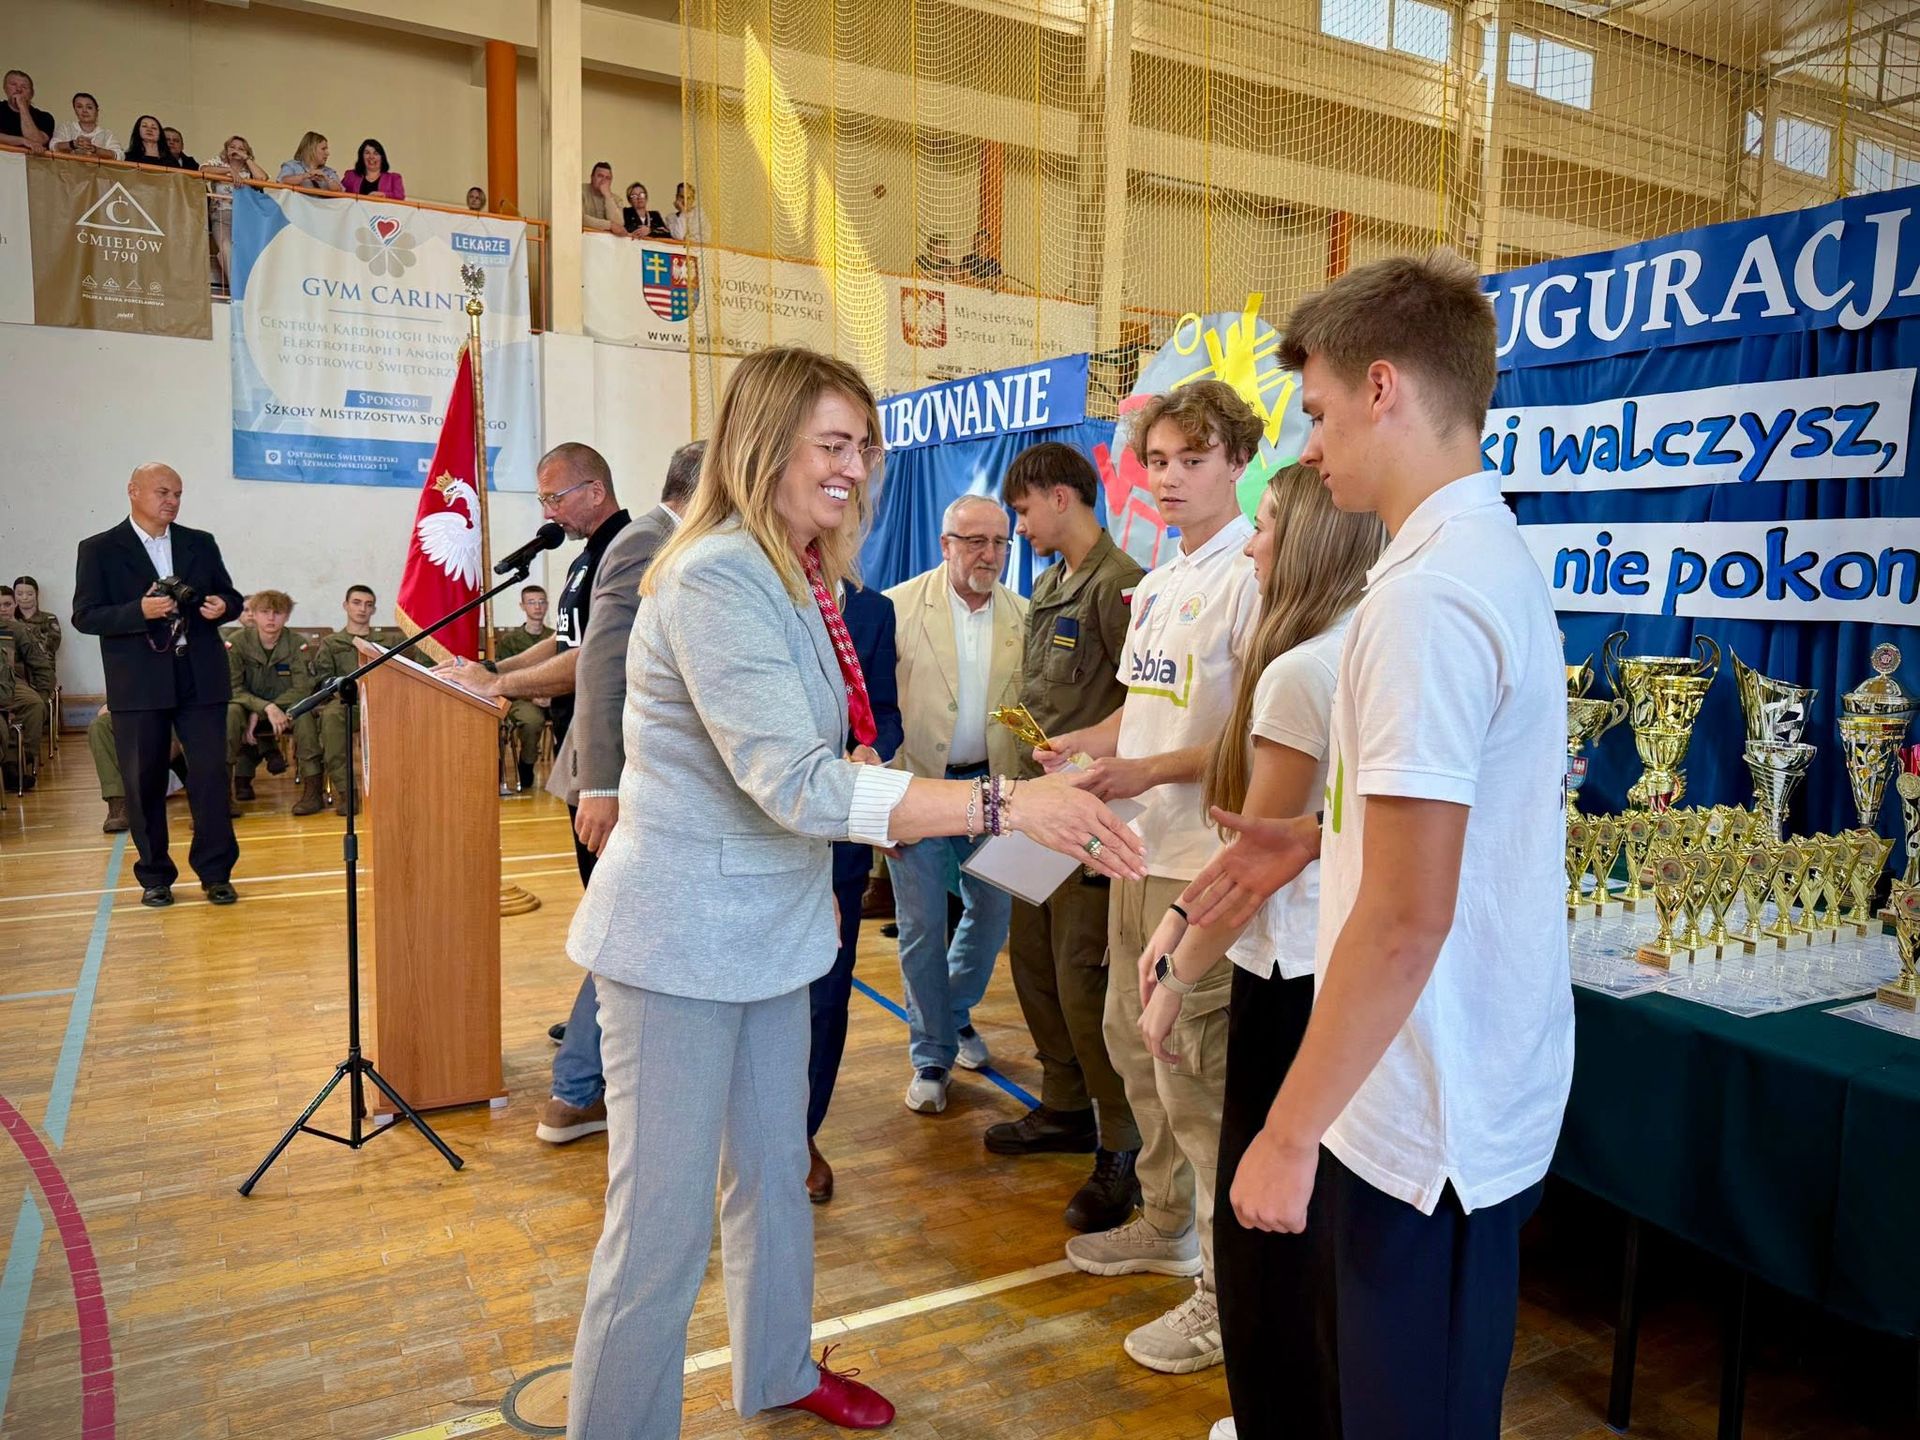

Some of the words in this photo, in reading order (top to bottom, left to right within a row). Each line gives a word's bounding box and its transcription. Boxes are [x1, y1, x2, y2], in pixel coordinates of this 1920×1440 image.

[76, 229, 163, 254] ĆMIELÓW
[455, 235, 507, 253] LEKARZE
[103, 250, 139, 264] 1790
[302, 277, 361, 301] GVM
[1539, 401, 1898, 482] walczysz,
[1553, 531, 1649, 595] nie
[1661, 527, 1920, 615] pokon
